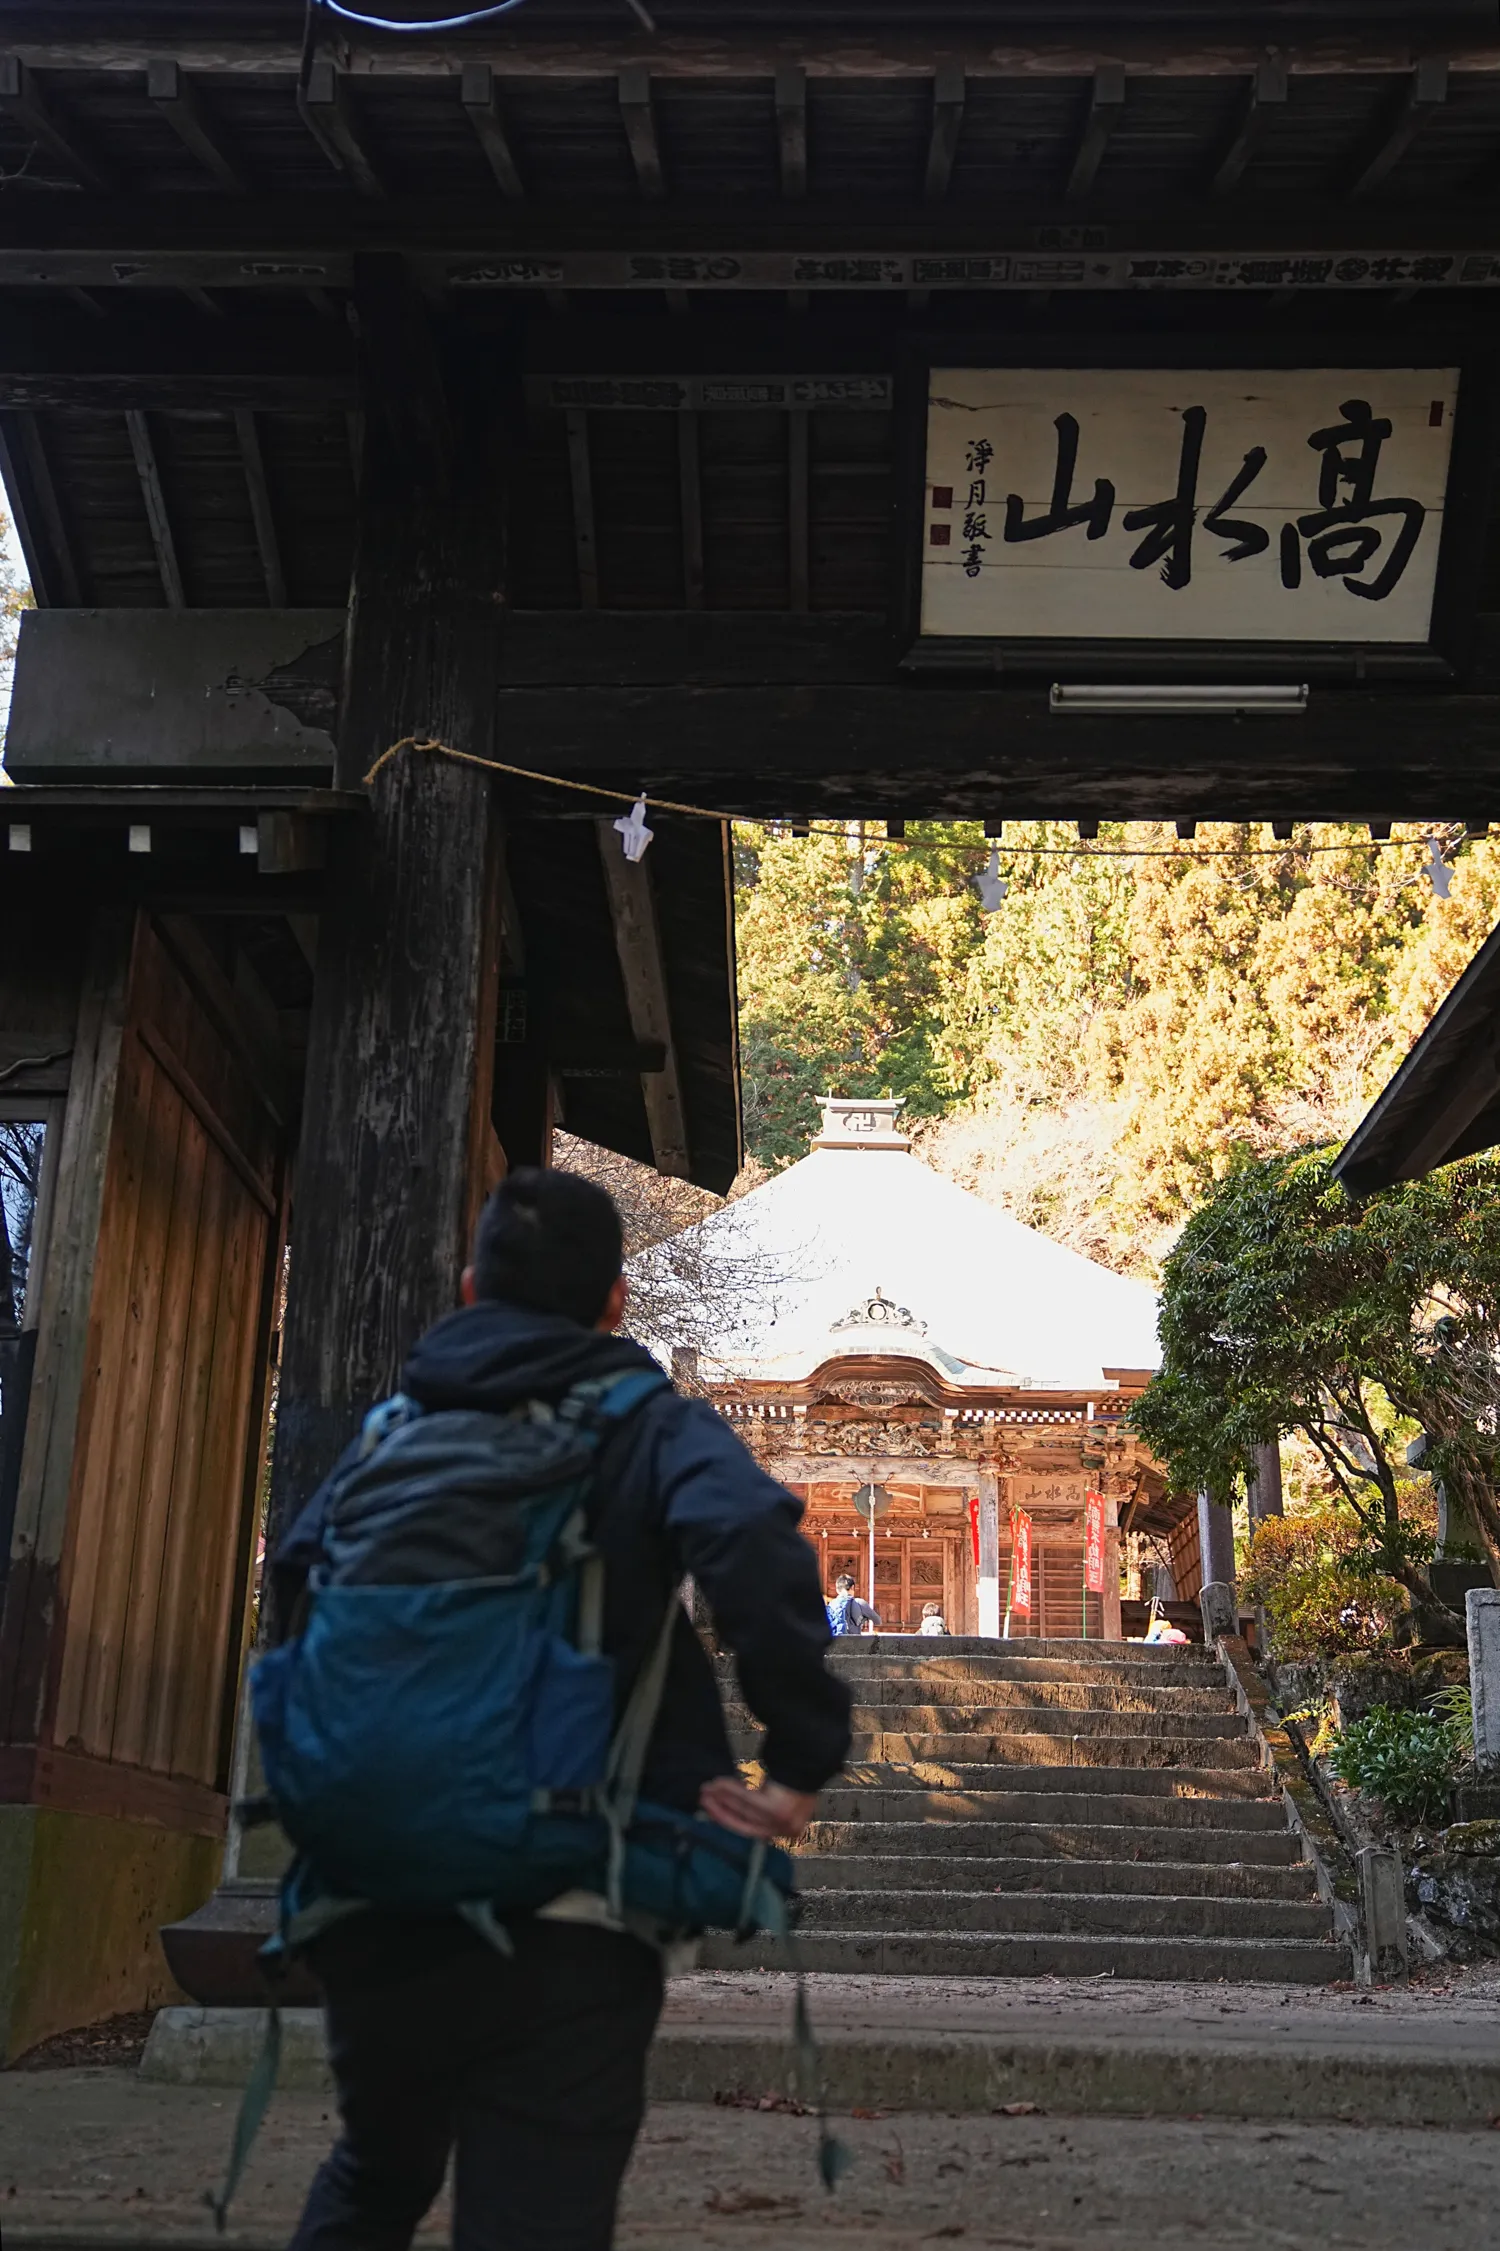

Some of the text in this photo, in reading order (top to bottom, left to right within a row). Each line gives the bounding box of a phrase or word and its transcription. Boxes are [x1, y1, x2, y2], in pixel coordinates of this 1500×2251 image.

[1003, 399, 1426, 602] 高水山
[1025, 1484, 1081, 1501] 高水山
